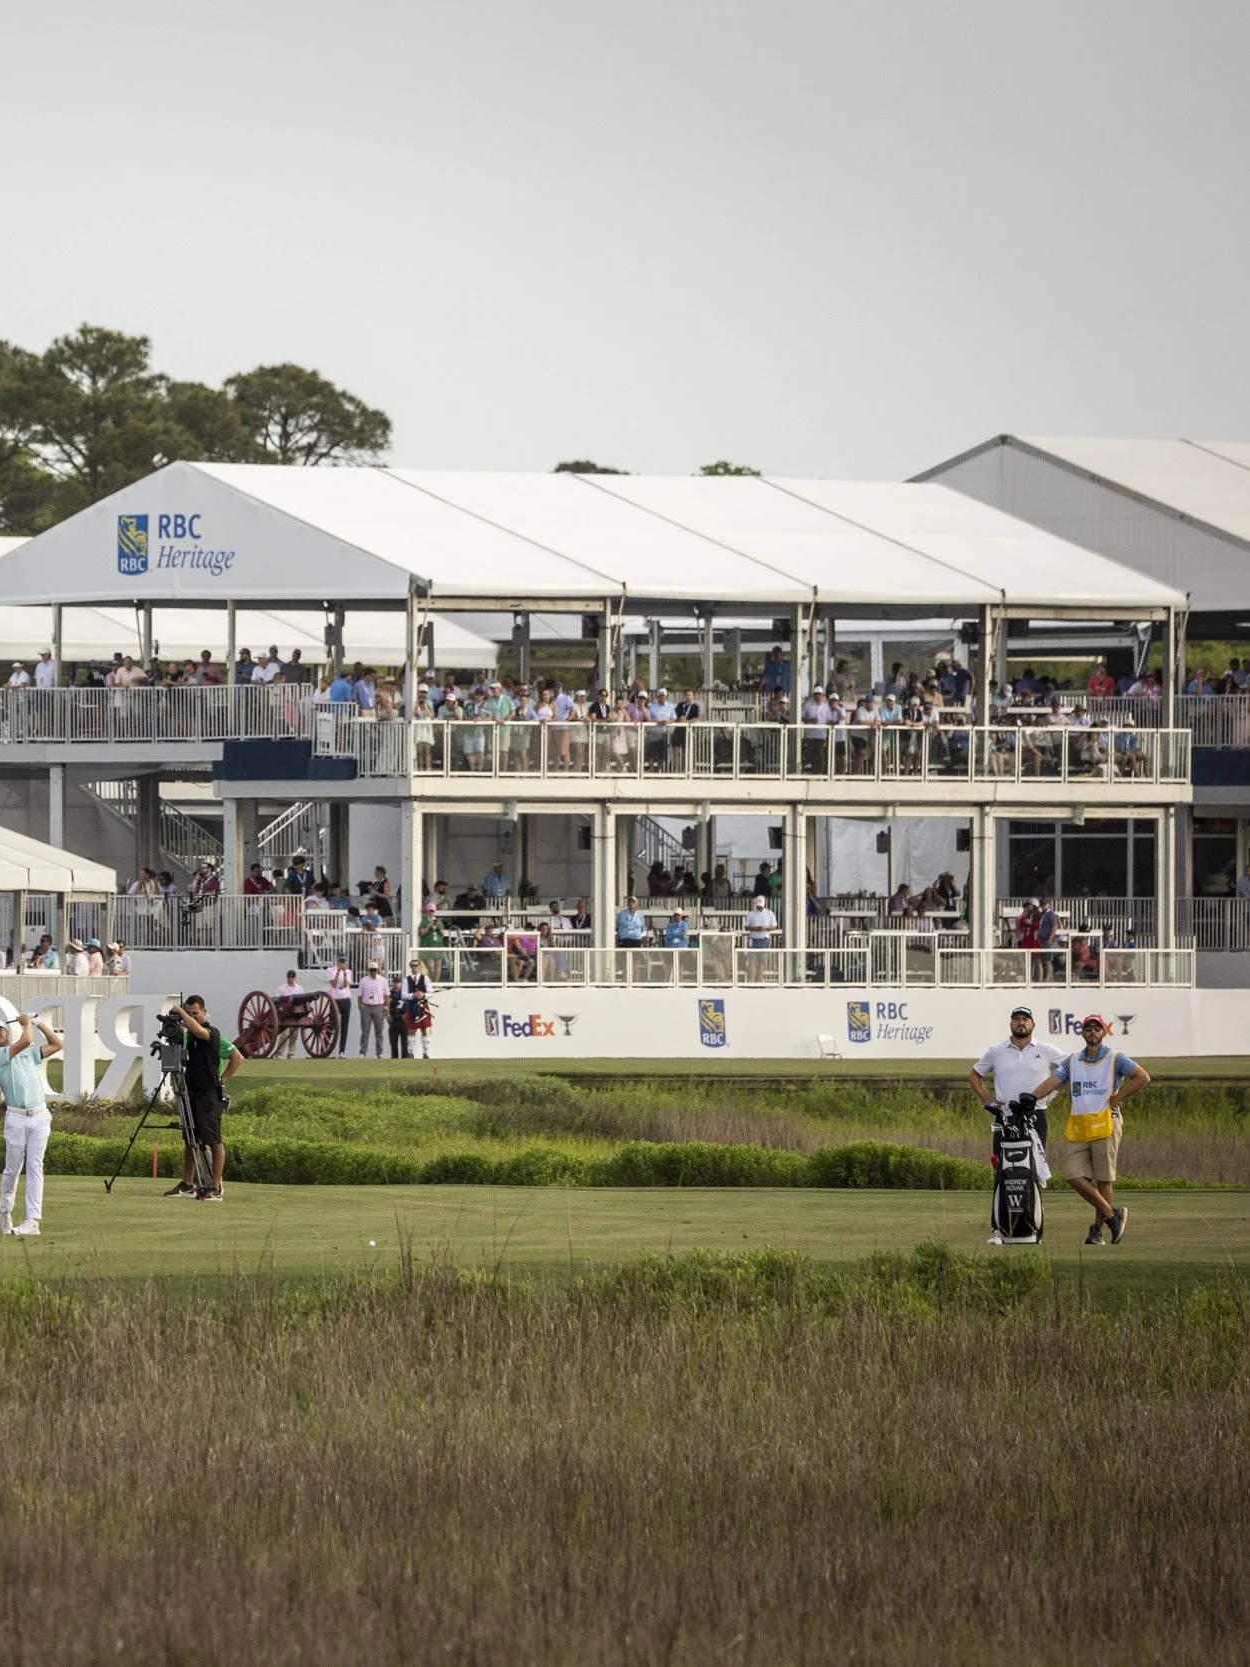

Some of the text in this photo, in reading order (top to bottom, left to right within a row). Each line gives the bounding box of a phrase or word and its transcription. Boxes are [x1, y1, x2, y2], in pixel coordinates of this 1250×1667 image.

[158, 514, 201, 539] RBC
[120, 558, 146, 571] RBC
[156, 545, 235, 576] Heritage
[876, 1002, 908, 1020] RBC
[502, 1014, 555, 1037] FedEx
[876, 1023, 933, 1044] Heritage
[1065, 1013, 1114, 1036] Fex
[702, 1032, 725, 1045] RBC
[850, 1030, 869, 1041] RBC
[1082, 1081, 1098, 1089] RBC
[1008, 1194, 1023, 1207] W
